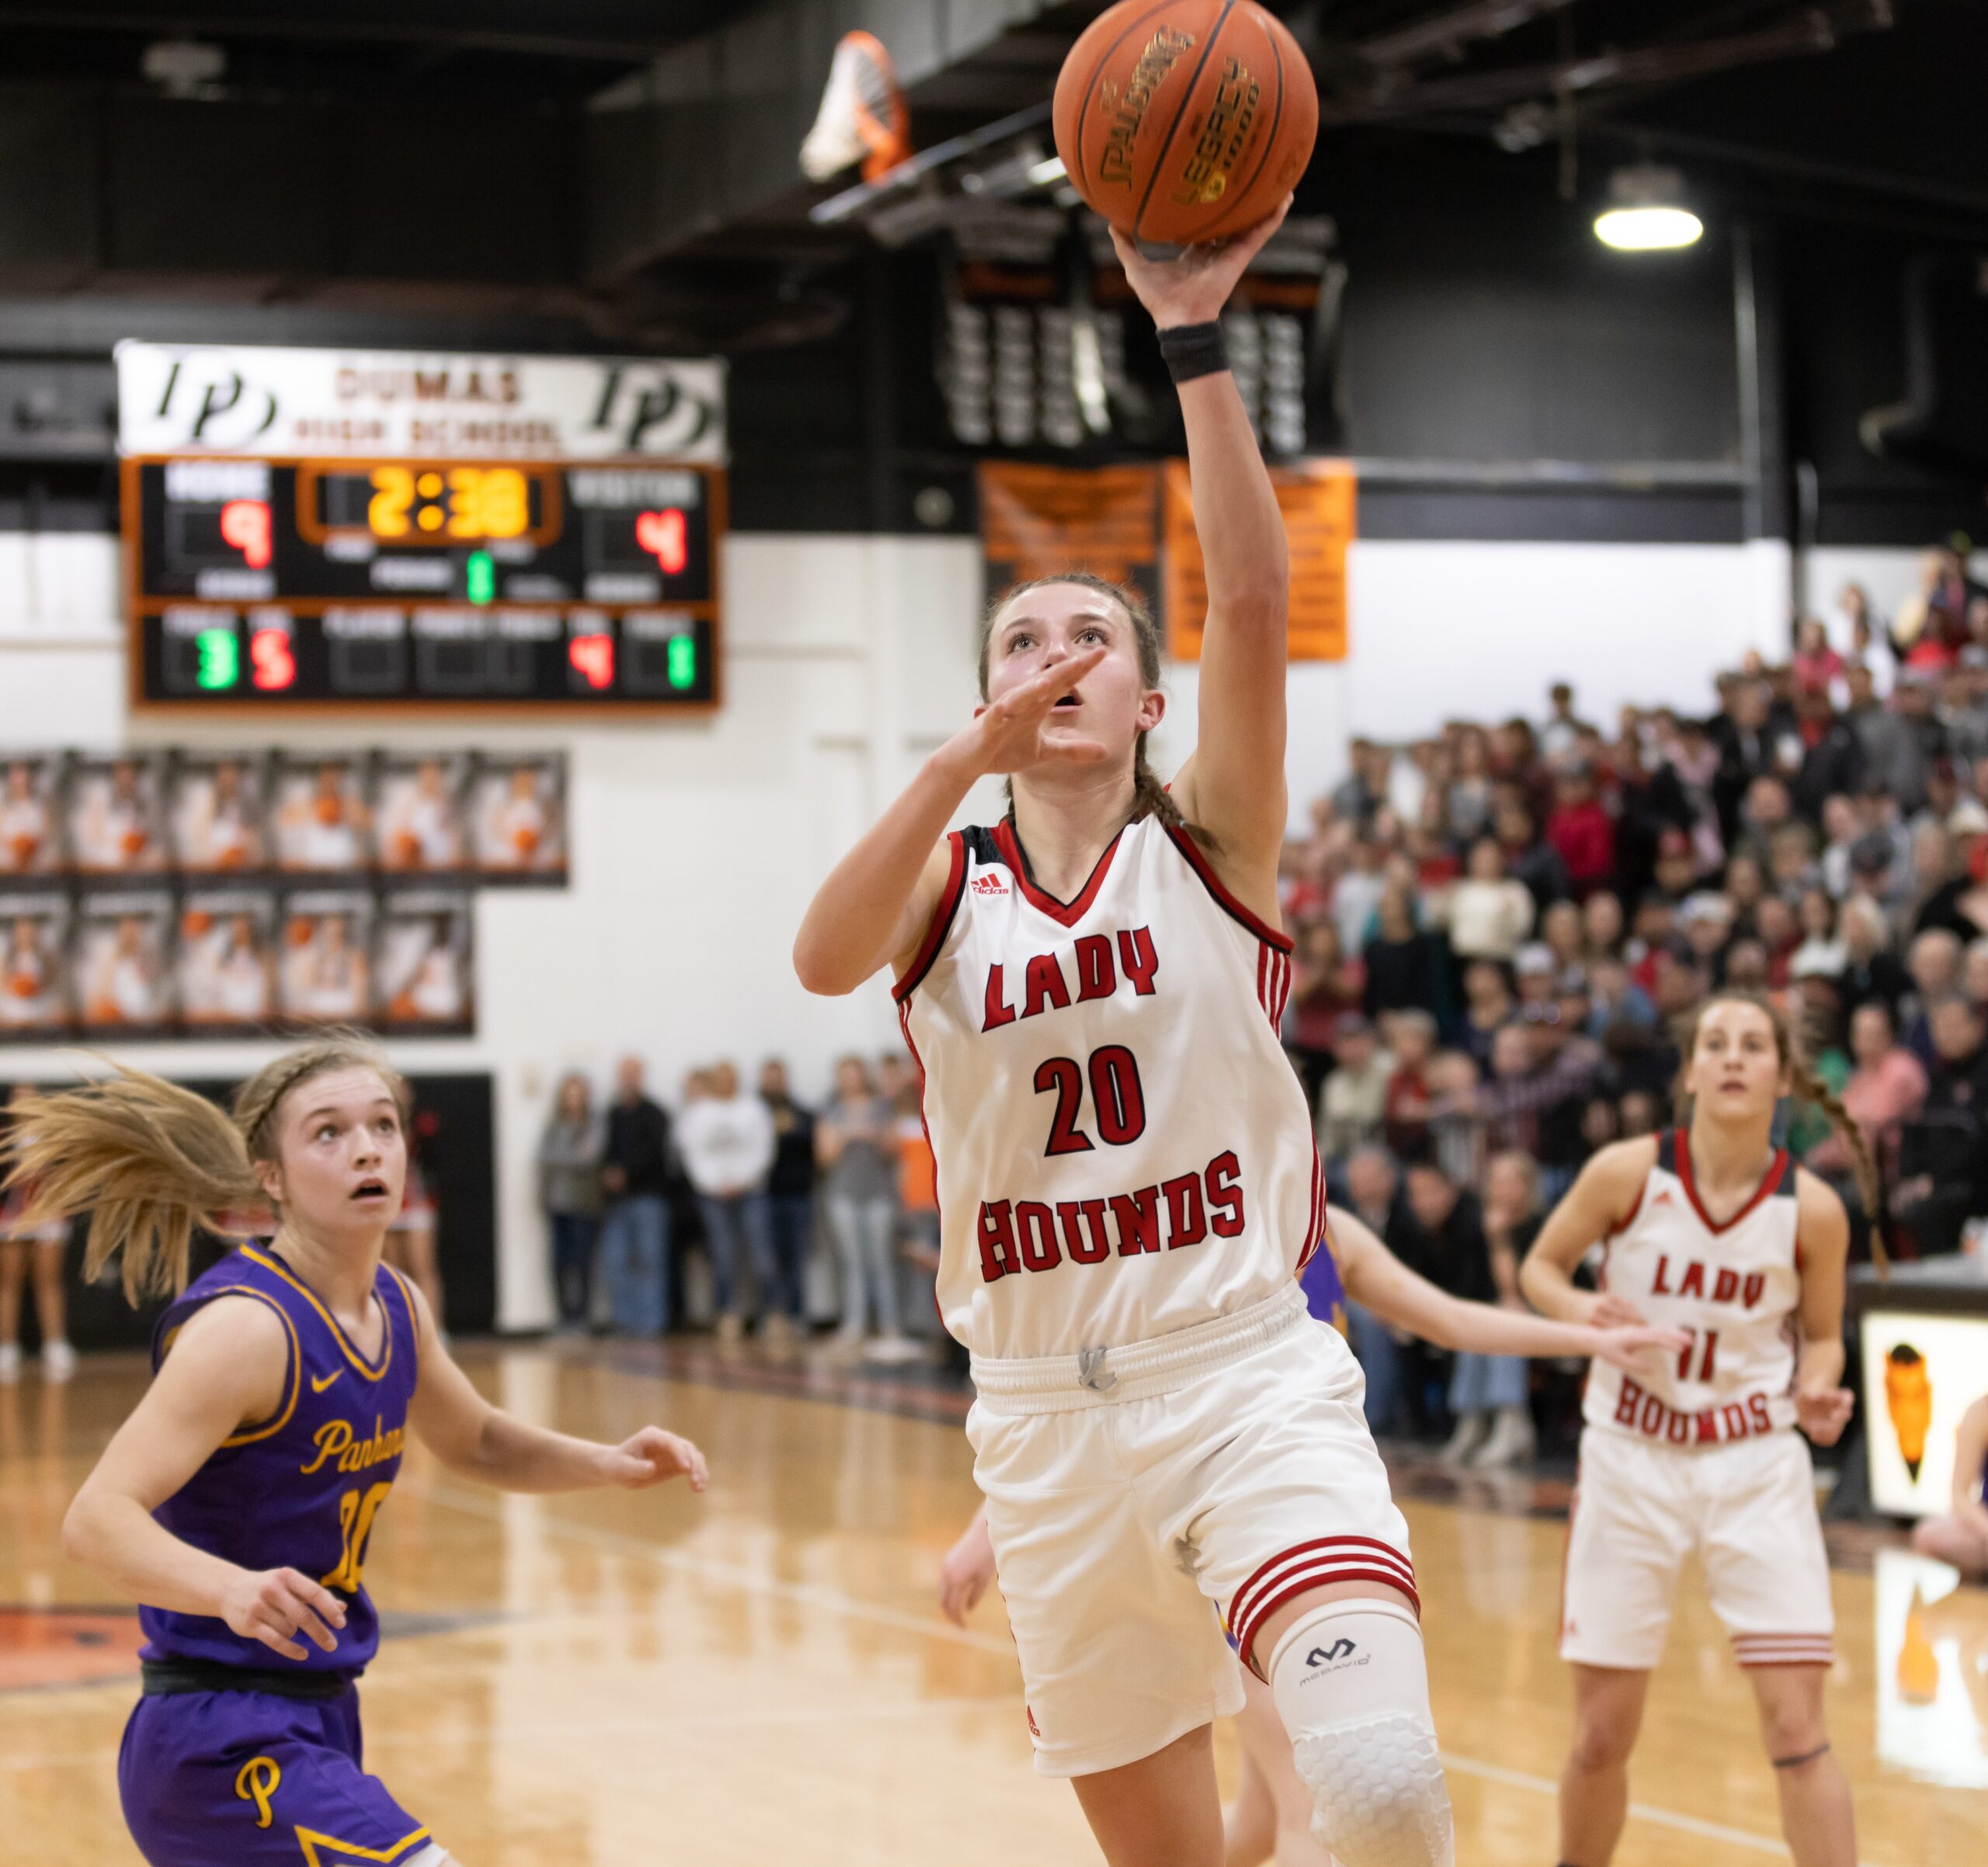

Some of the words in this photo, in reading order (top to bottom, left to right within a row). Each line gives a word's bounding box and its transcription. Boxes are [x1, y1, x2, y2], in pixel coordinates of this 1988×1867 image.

[1172, 57, 1248, 205] LEGACY
[335, 367, 523, 402] DUMAS
[220, 499, 272, 570] 9
[636, 507, 686, 575] 4
[196, 628, 238, 690] 3
[251, 628, 295, 690] 5
[569, 634, 614, 690] 4
[972, 886, 1009, 895] adidas
[982, 924, 1159, 1034] LADY
[1033, 1044, 1147, 1157] 20
[977, 1149, 1246, 1284] HOUNDS
[1651, 1253, 1766, 1310] LADY
[1677, 1325, 1719, 1383] 11
[1614, 1373, 1773, 1445] HOUNDS
[235, 1756, 280, 1829] P
